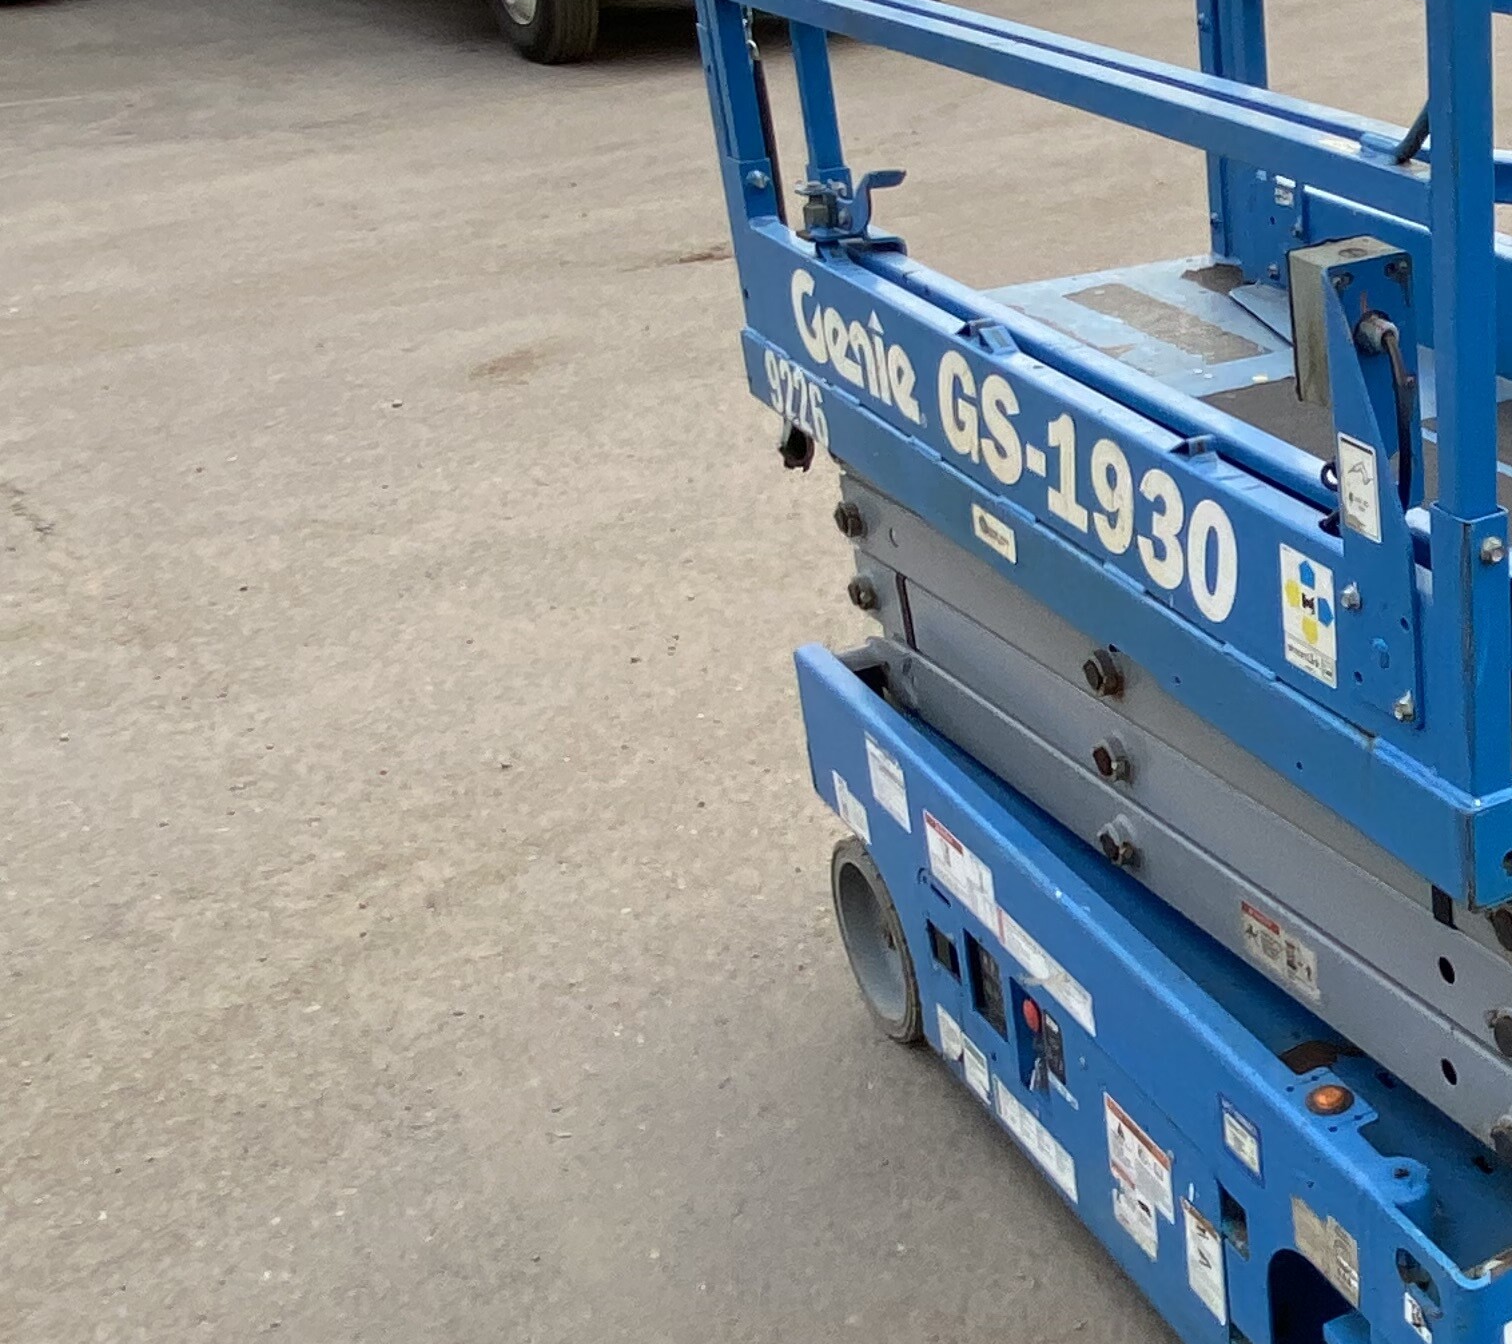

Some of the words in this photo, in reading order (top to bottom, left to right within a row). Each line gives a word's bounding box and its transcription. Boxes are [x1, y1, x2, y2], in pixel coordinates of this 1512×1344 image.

[764, 349, 829, 448] 9226
[791, 268, 922, 425] Genie
[938, 350, 1238, 624] GS-1930
